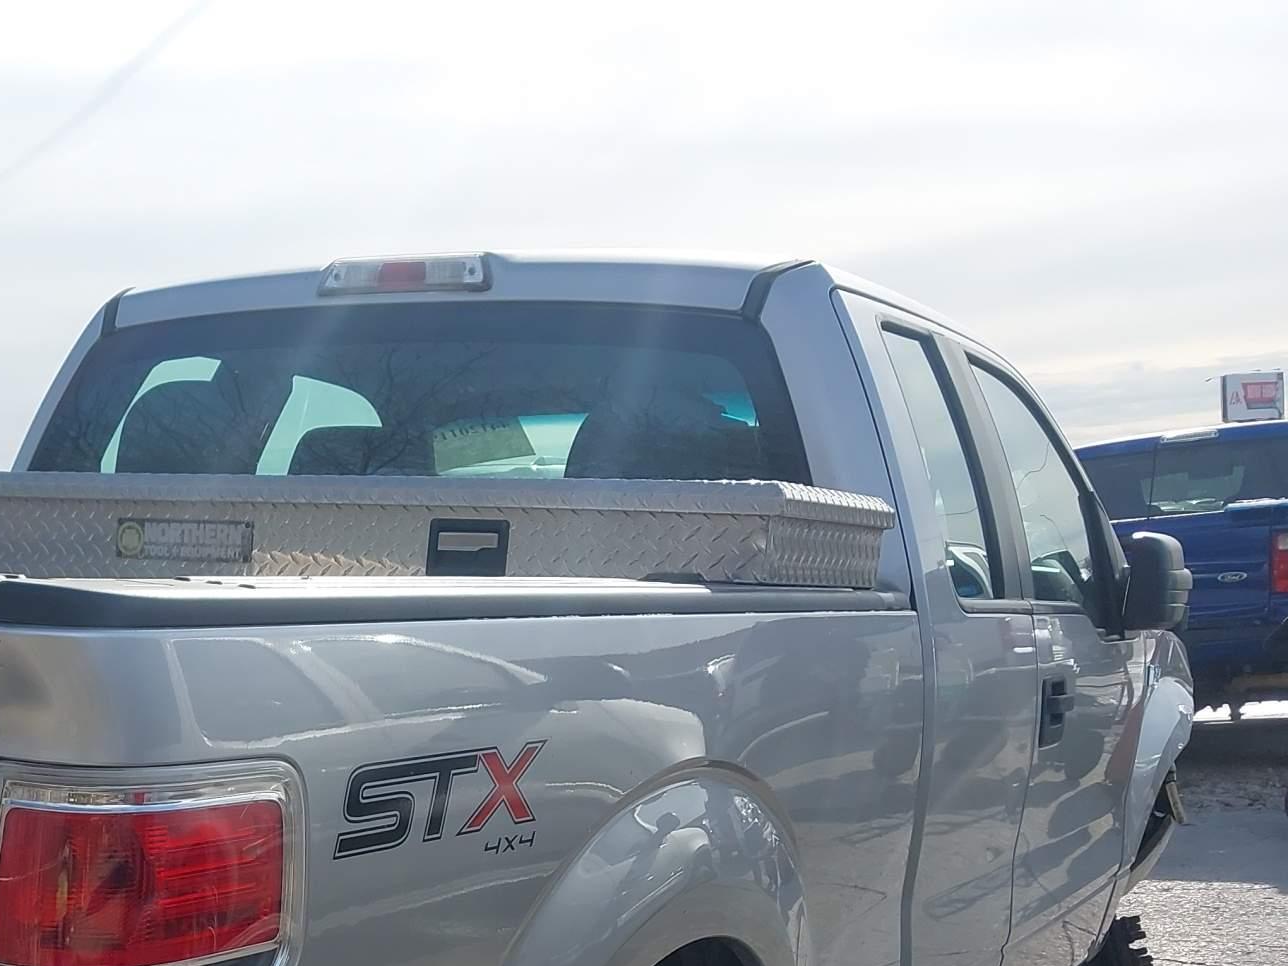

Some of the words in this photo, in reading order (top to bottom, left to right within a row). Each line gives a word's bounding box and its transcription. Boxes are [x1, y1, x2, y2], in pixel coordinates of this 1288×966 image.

[144, 521, 241, 545] NORTHERN
[143, 544, 169, 557] TOOL
[332, 739, 549, 861] STX
